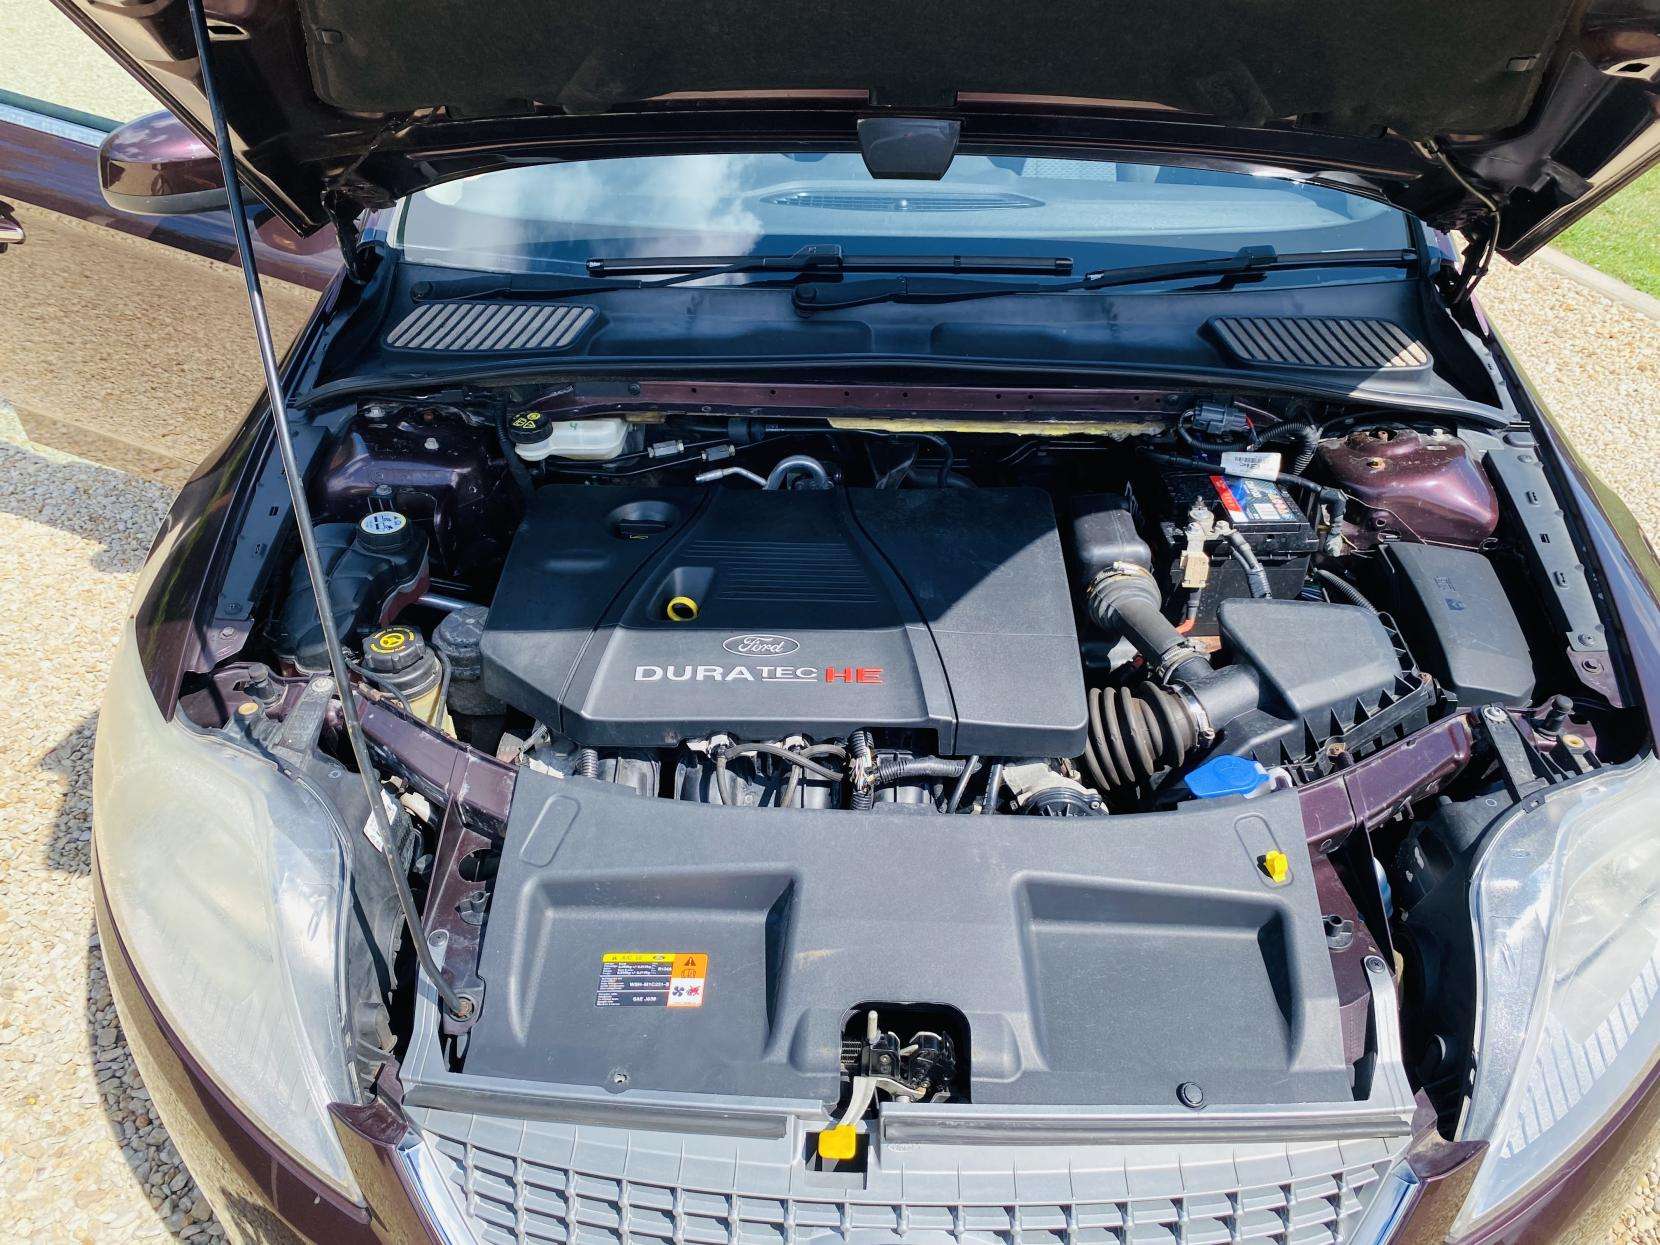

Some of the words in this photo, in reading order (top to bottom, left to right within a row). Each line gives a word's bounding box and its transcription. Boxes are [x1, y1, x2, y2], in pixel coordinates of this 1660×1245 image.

[738, 637, 784, 653] Ford
[634, 665, 818, 682] DURATEC
[825, 666, 884, 684] HE
